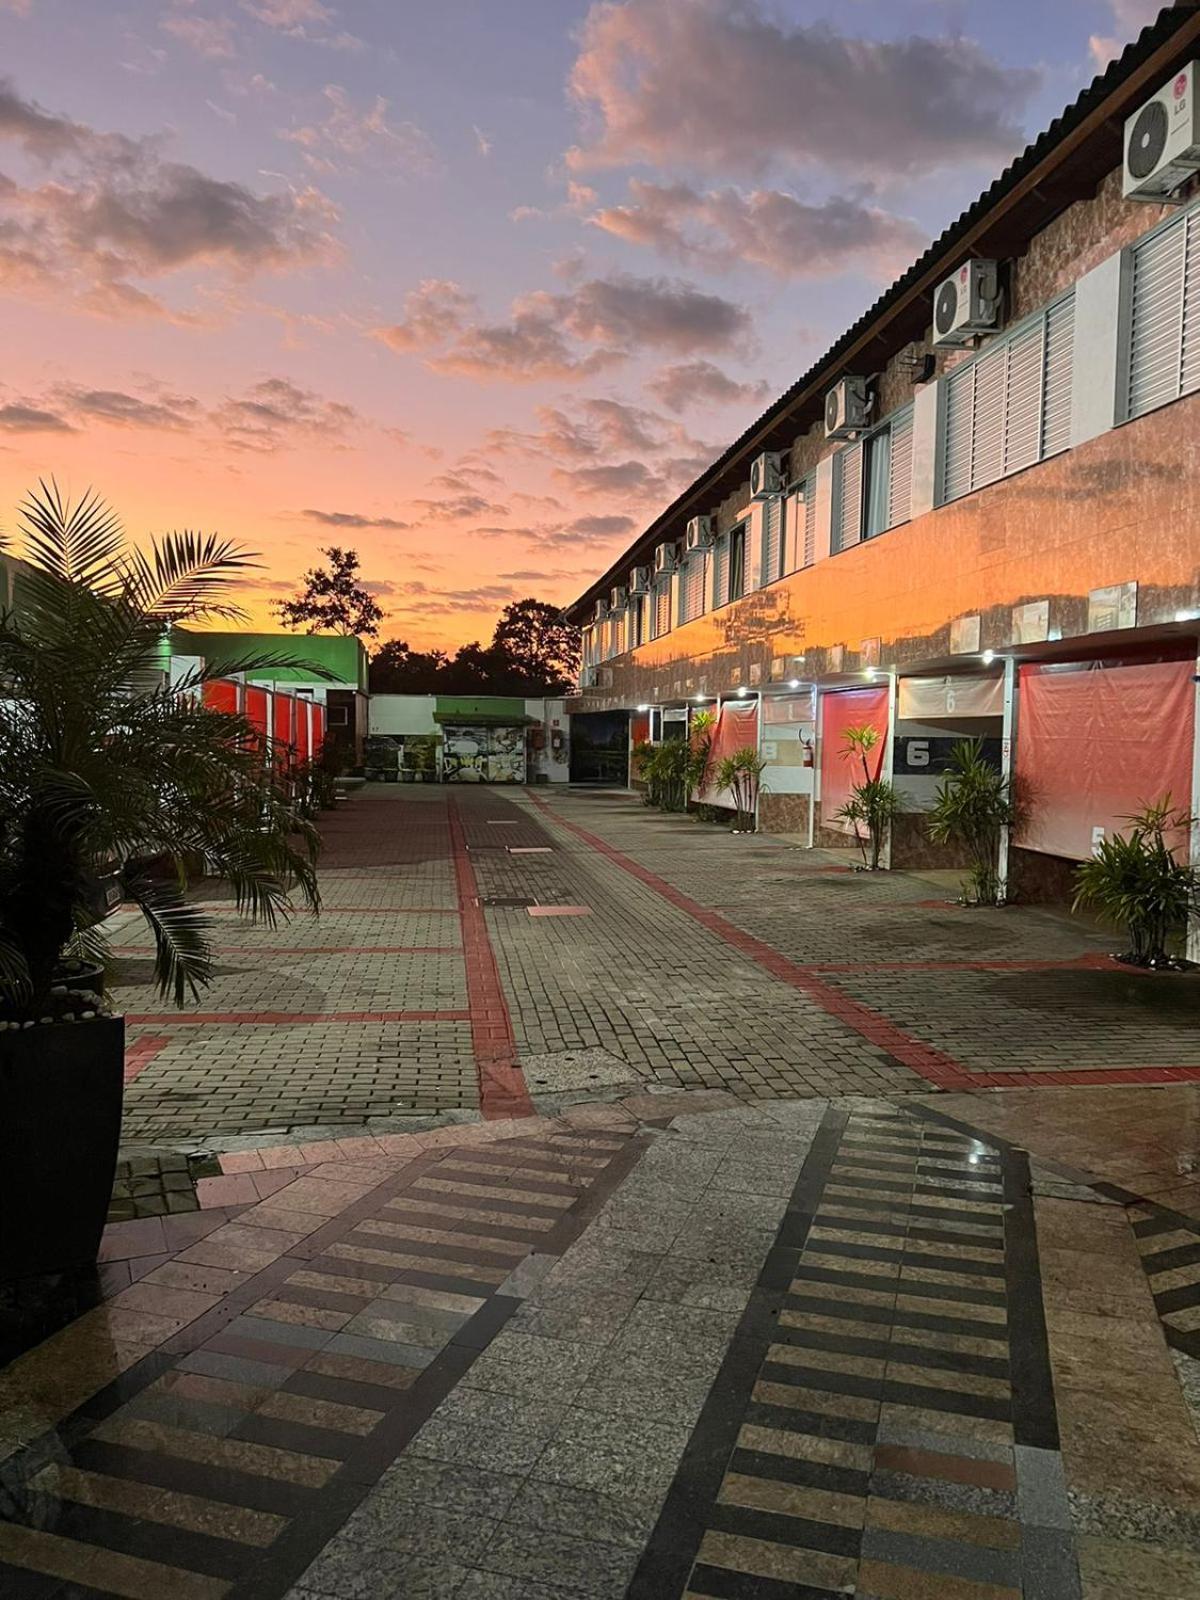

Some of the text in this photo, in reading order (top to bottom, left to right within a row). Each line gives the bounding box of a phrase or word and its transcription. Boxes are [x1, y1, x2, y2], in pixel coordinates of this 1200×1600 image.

[1174, 99, 1186, 116] LG
[946, 689, 956, 714] 6
[907, 741, 930, 766] 6
